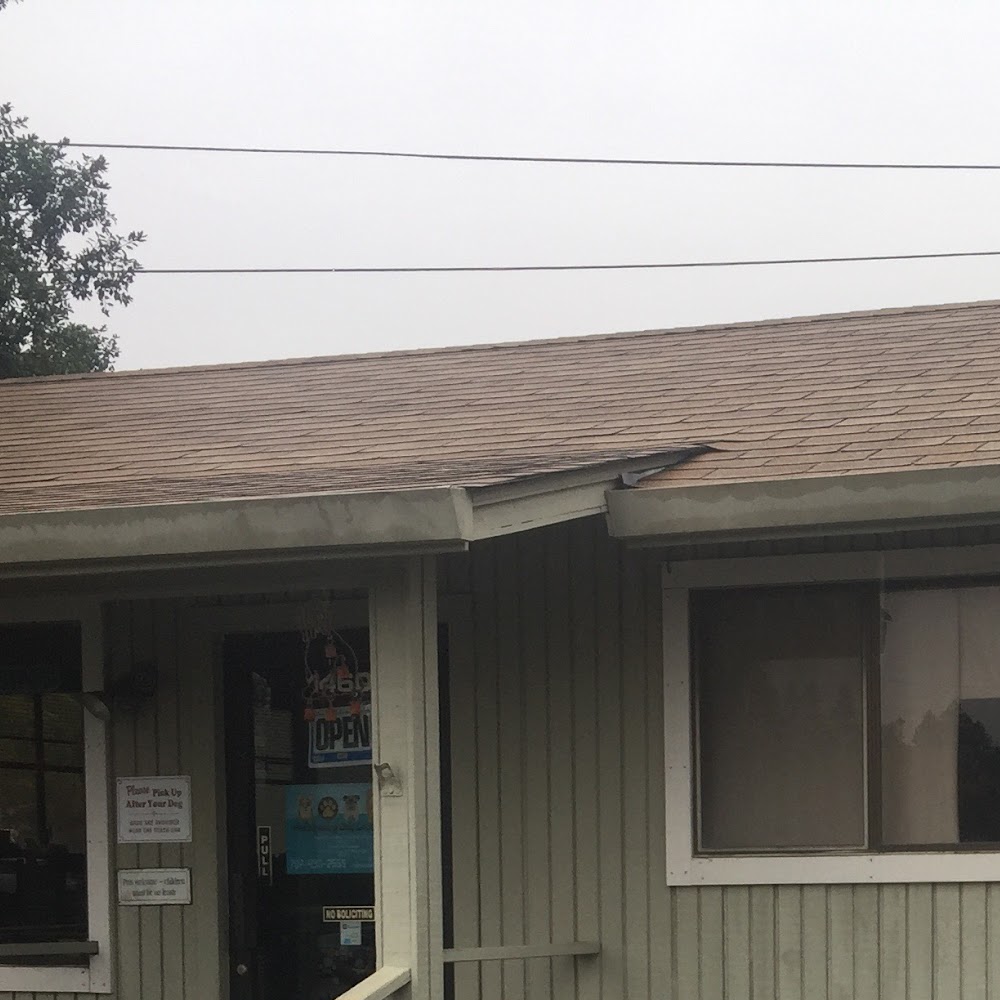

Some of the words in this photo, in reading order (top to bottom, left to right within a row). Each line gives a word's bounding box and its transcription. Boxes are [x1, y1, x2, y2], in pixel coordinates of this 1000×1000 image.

[315, 714, 369, 750] OPEN
[152, 788, 169, 797] Pick
[171, 788, 182, 798] Up
[126, 799, 147, 808] After
[147, 799, 167, 808] Your
[167, 799, 183, 809] Dog
[261, 835, 269, 876] PULL
[325, 909, 336, 919] NO
[336, 909, 373, 919] SOLICITING
